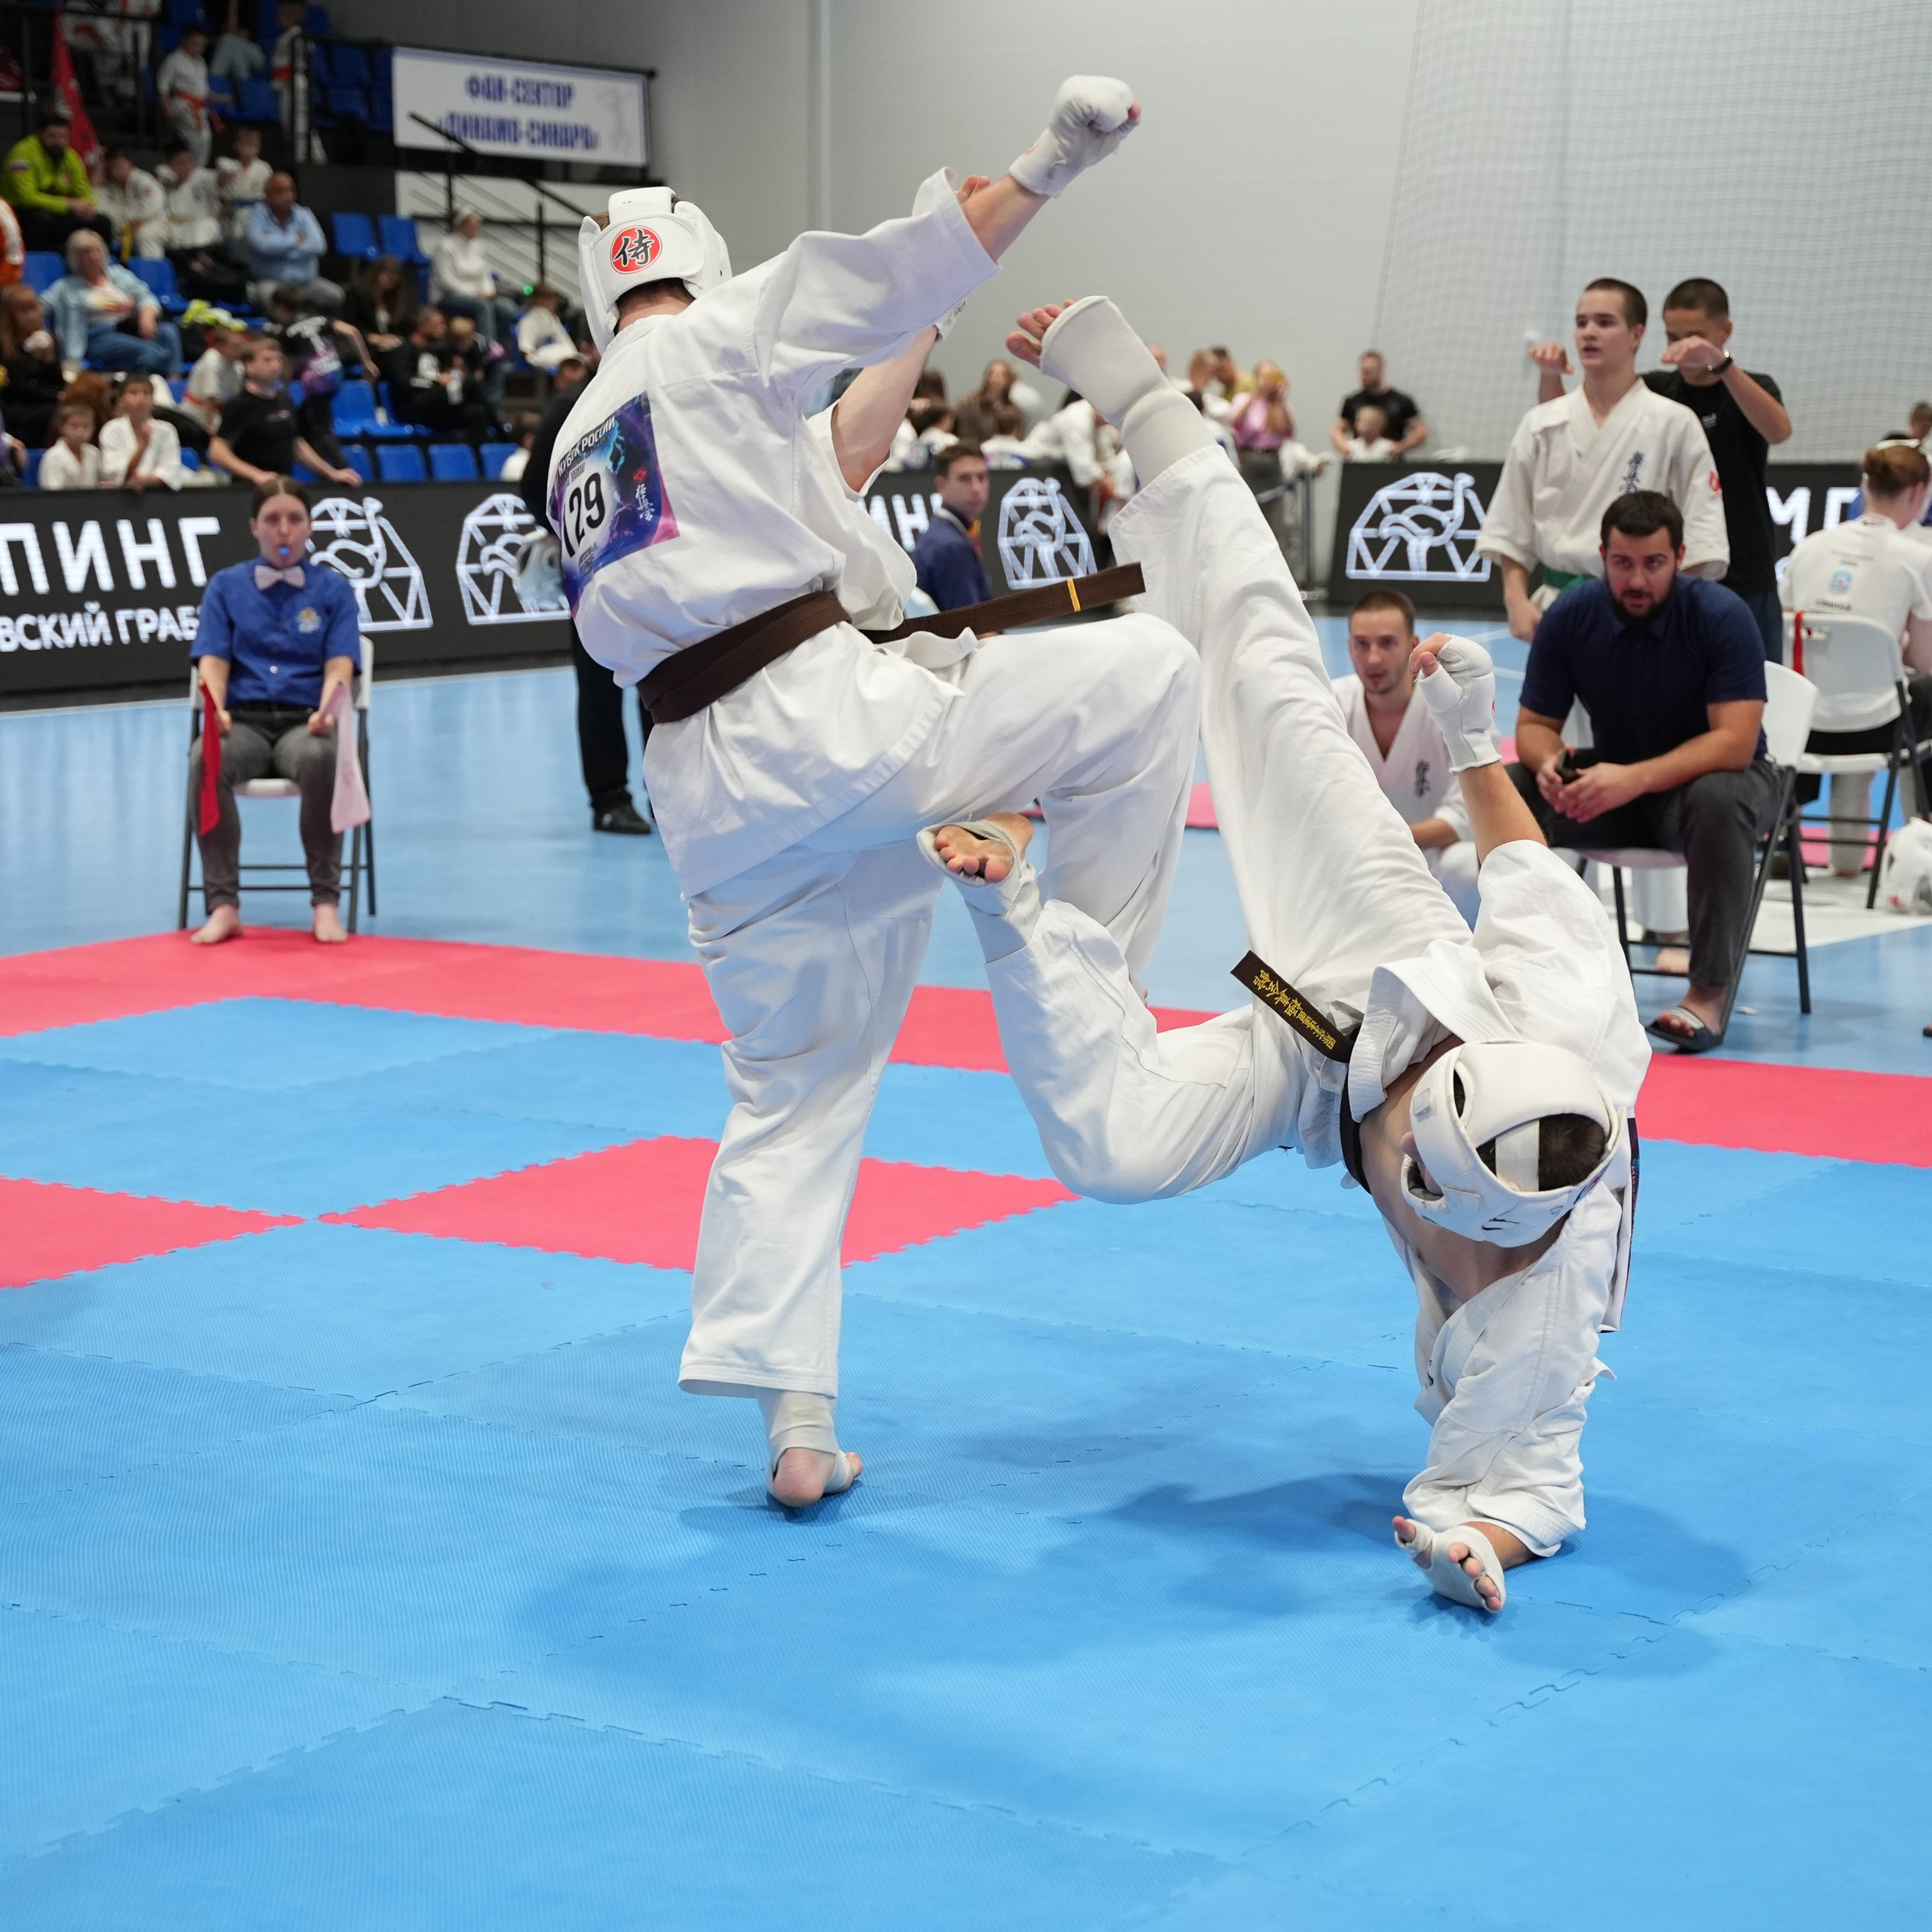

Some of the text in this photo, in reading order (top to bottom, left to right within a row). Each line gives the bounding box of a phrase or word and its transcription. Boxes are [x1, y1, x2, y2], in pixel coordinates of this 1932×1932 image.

[613, 229, 654, 266] 侍
[581, 416, 615, 452] РОССИИ
[0, 516, 221, 595] ПИНГ
[0, 601, 202, 652] ВСКИЙ ГРАБ
